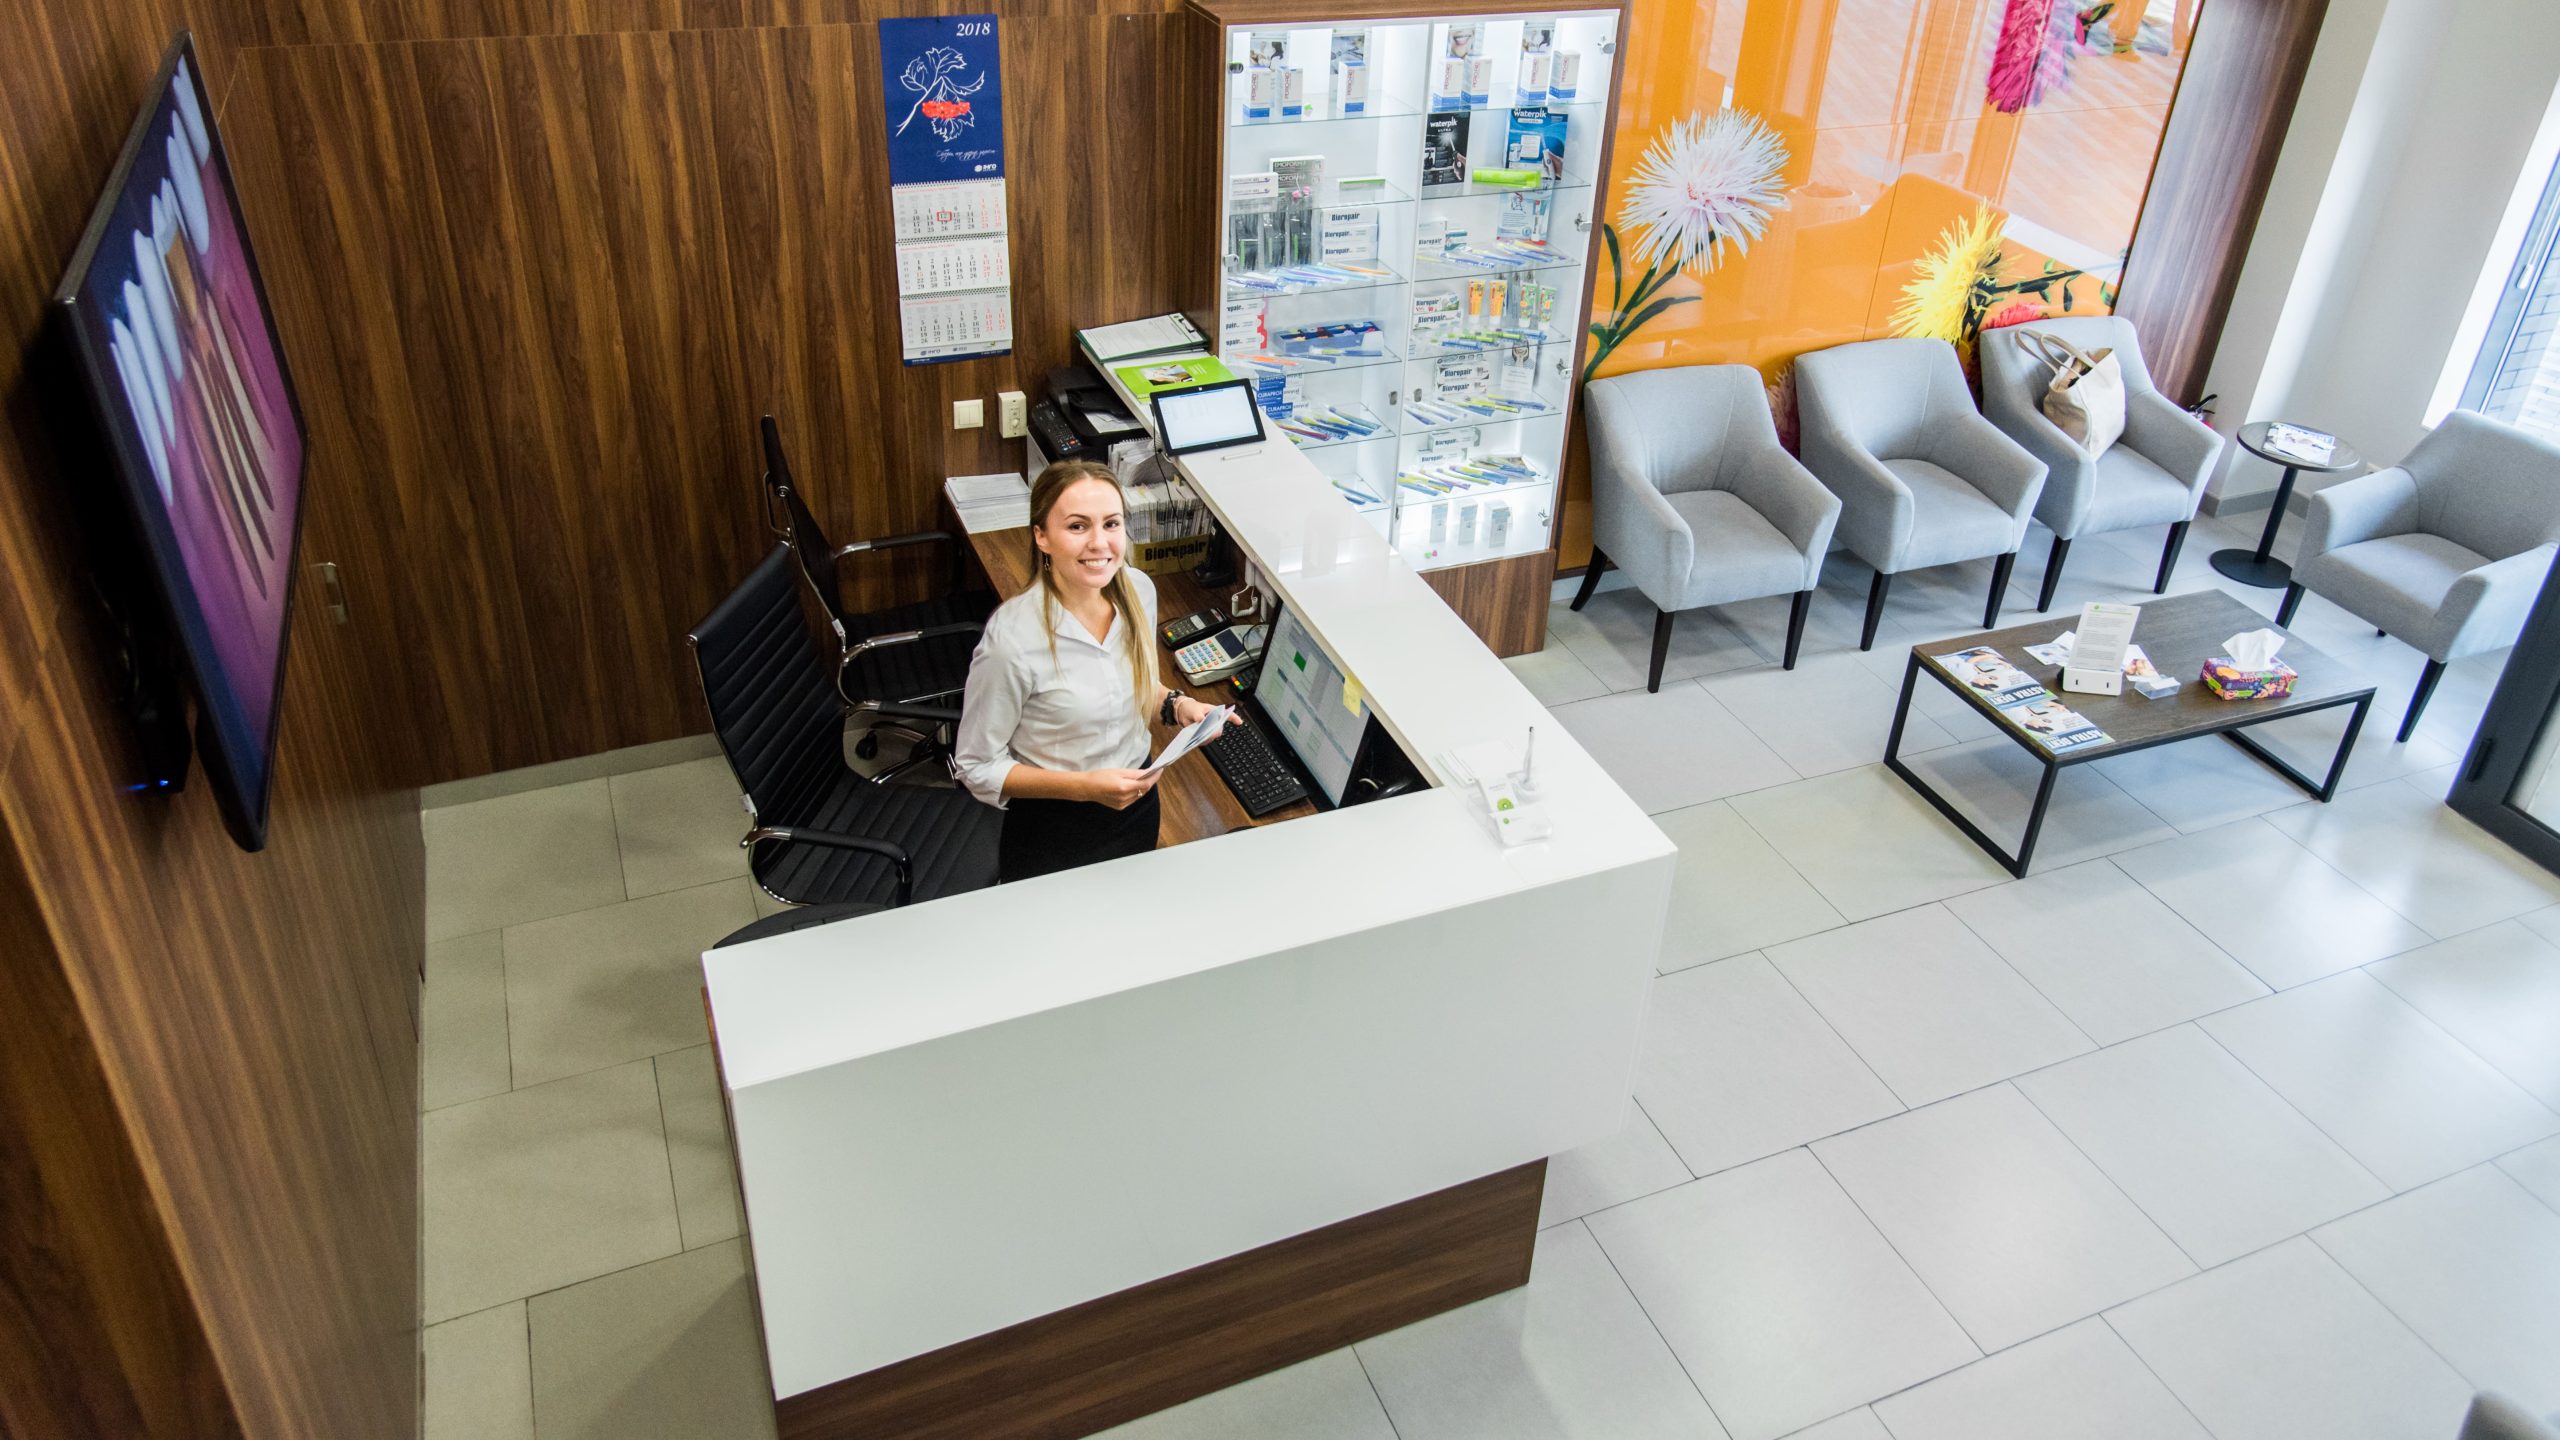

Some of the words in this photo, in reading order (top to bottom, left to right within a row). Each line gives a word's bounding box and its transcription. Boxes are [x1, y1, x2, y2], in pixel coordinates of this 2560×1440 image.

[956, 22, 990, 36] 2018
[1513, 108, 1546, 118] waterpik
[1430, 116, 1458, 128] waterpik
[1332, 212, 1360, 222] Biorepair
[1418, 314, 1446, 324] Biorepair
[1444, 368, 1472, 378] Biorepair
[1442, 383, 1470, 392] Biorepair
[1144, 541, 1206, 562] Biorepair
[2015, 686, 2046, 700] ASTRA
[2070, 730, 2102, 744] ASTRA
